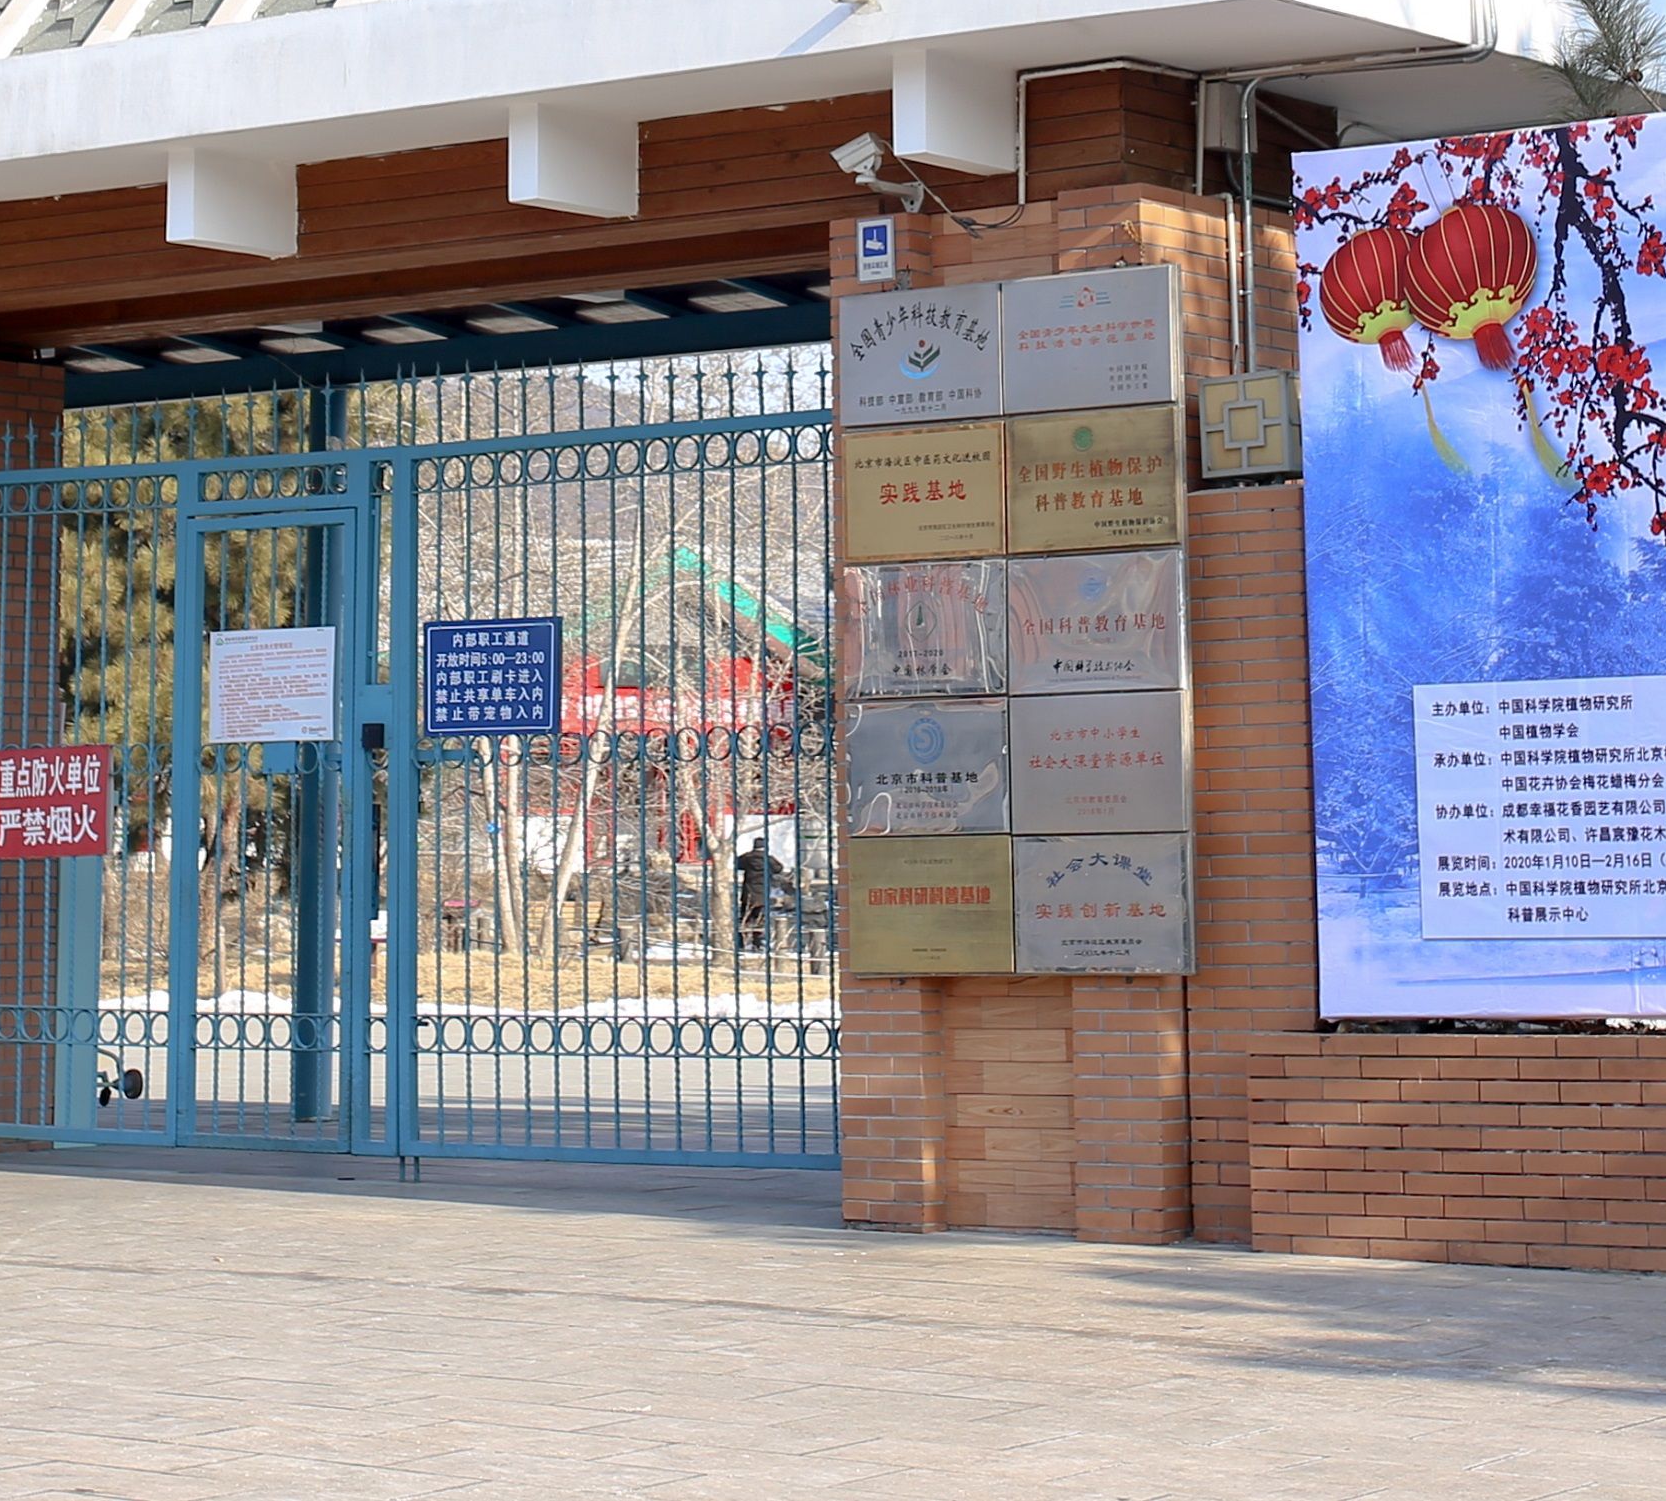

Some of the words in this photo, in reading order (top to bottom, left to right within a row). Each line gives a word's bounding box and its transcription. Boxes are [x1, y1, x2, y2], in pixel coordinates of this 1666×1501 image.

[850, 301, 991, 361] 全国青少年科技教育基地
[854, 450, 991, 469] 北京市海淀区中医药文化进校园
[1018, 455, 1164, 483] 全国野生植物保护
[879, 479, 967, 506] 实践基地
[1035, 487, 1144, 513] 科普教育基地
[1023, 612, 1167, 636] 全国科普教育基地
[452, 630, 529, 648] 内部职工通道
[436, 668, 544, 686] 内部职工刷卡进入
[435, 685, 544, 705] 禁止共享单车入内
[435, 703, 544, 723] 禁止带宠物入内
[1049, 726, 1141, 742] 北京市中小学生
[1499, 722, 1580, 741] 中国植物学会
[1028, 751, 1165, 770] 社会大课堂资源单位
[876, 771, 979, 786] 北京市科普基地
[1501, 772, 1665, 792] 中国花卉协会梅花蜡梅分会
[1045, 852, 1155, 889] 社会大课堂
[868, 886, 991, 907] 国家科研科普基地
[1035, 902, 1167, 920] 实践创新基地
[1507, 906, 1589, 923] 科普展示中心
